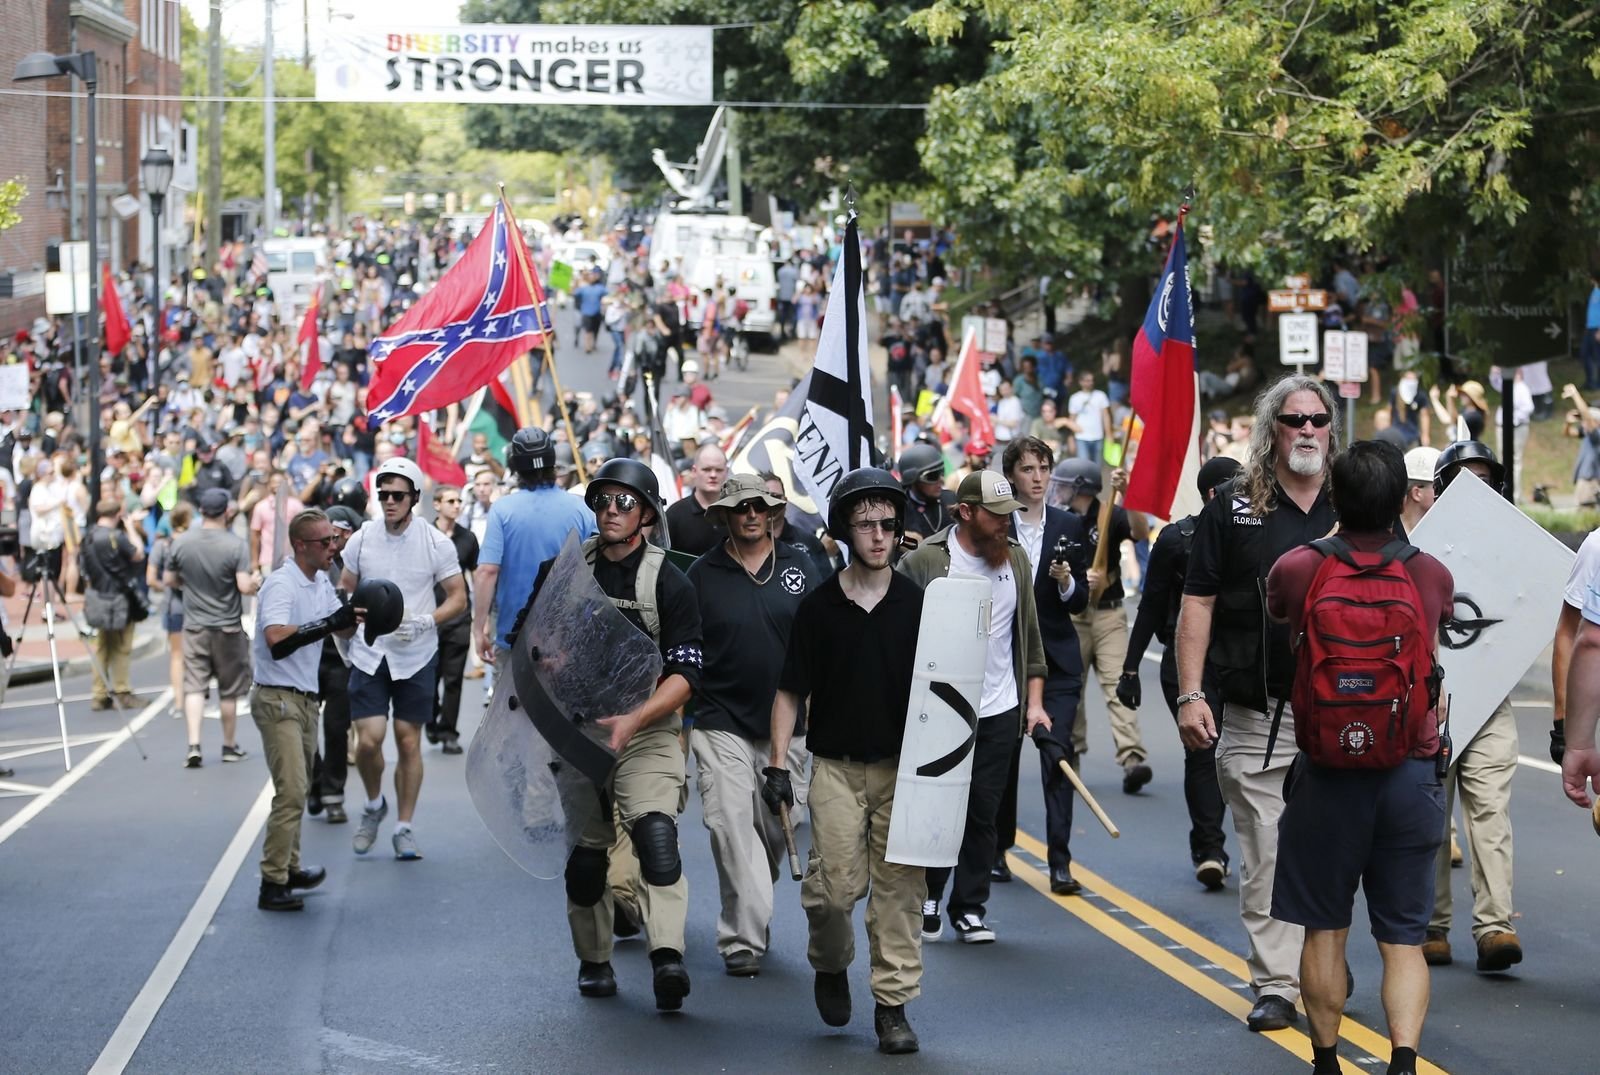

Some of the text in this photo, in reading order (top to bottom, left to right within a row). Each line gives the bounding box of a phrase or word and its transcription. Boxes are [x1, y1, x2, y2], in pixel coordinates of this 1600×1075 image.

[387, 33, 643, 54] DIVERSITY makes us
[385, 57, 645, 94] STRONGER
[1501, 301, 1553, 320] Square
[1287, 320, 1310, 331] ONE
[1233, 515, 1263, 526] FLORIDA
